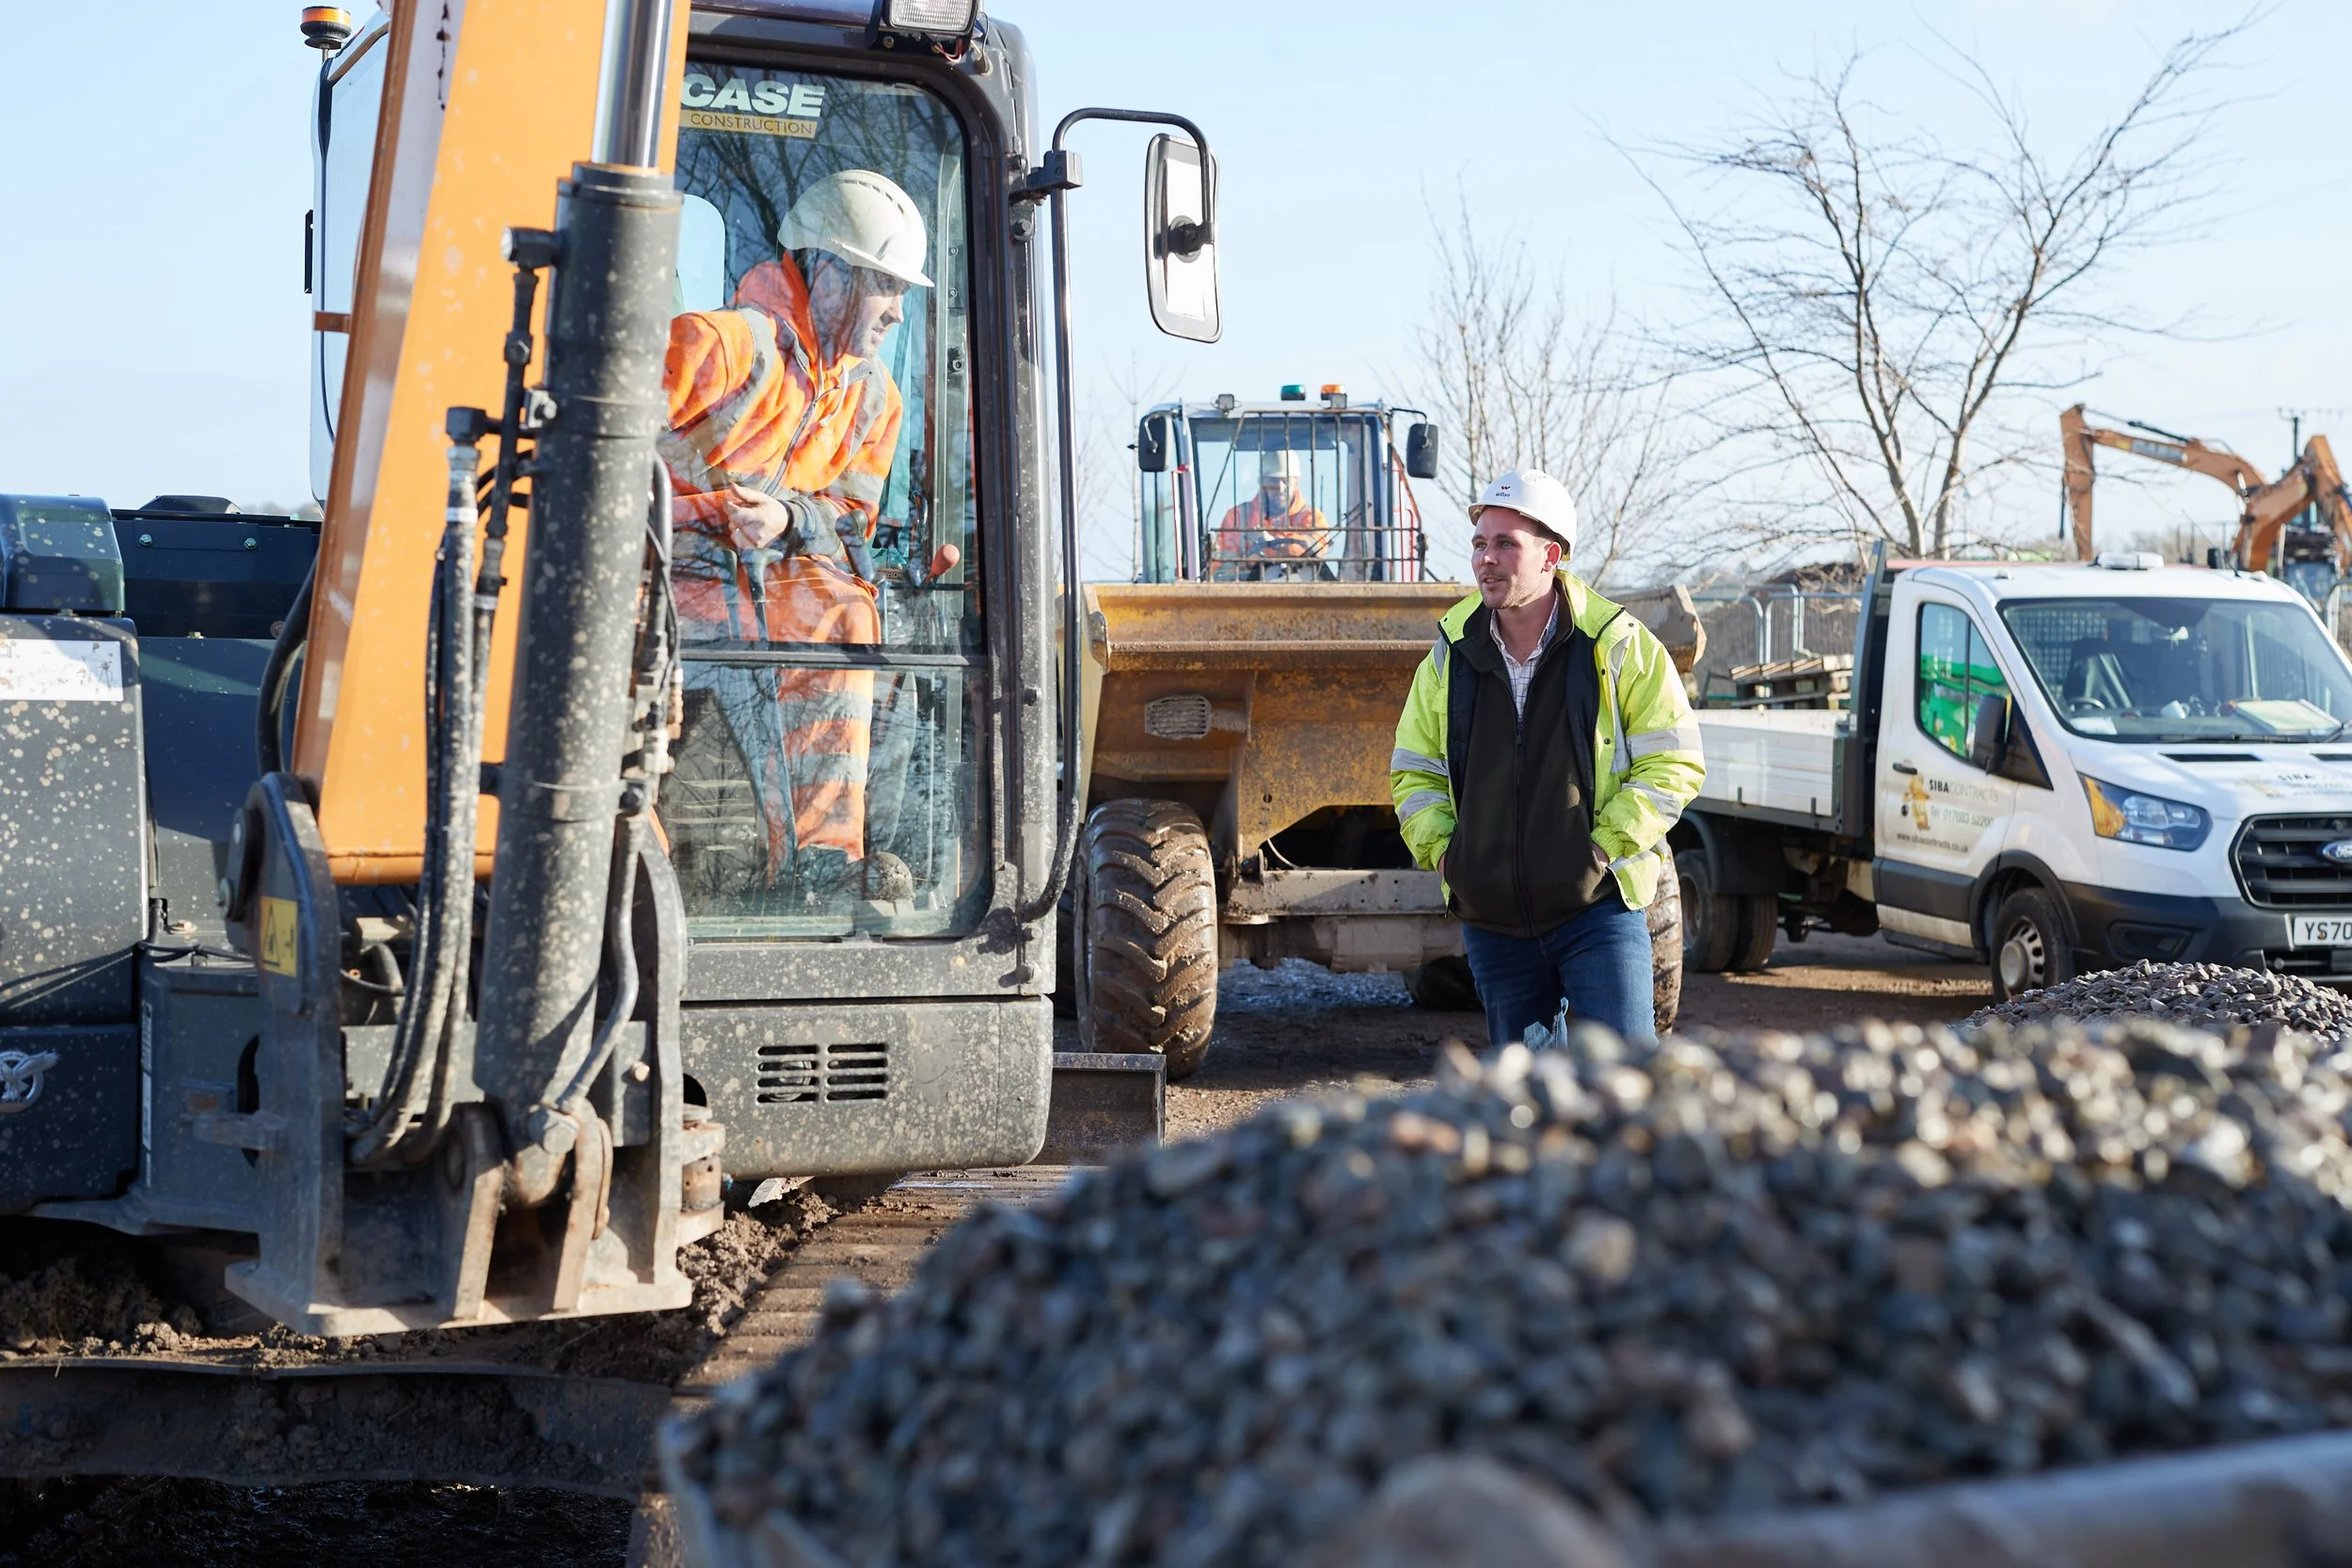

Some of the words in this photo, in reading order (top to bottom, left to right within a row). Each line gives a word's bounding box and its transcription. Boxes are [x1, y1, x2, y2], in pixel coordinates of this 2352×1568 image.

[681, 73, 826, 118] CASE
[691, 114, 813, 135] CONSTRUCTION
[2305, 922, 2352, 941] YS70
